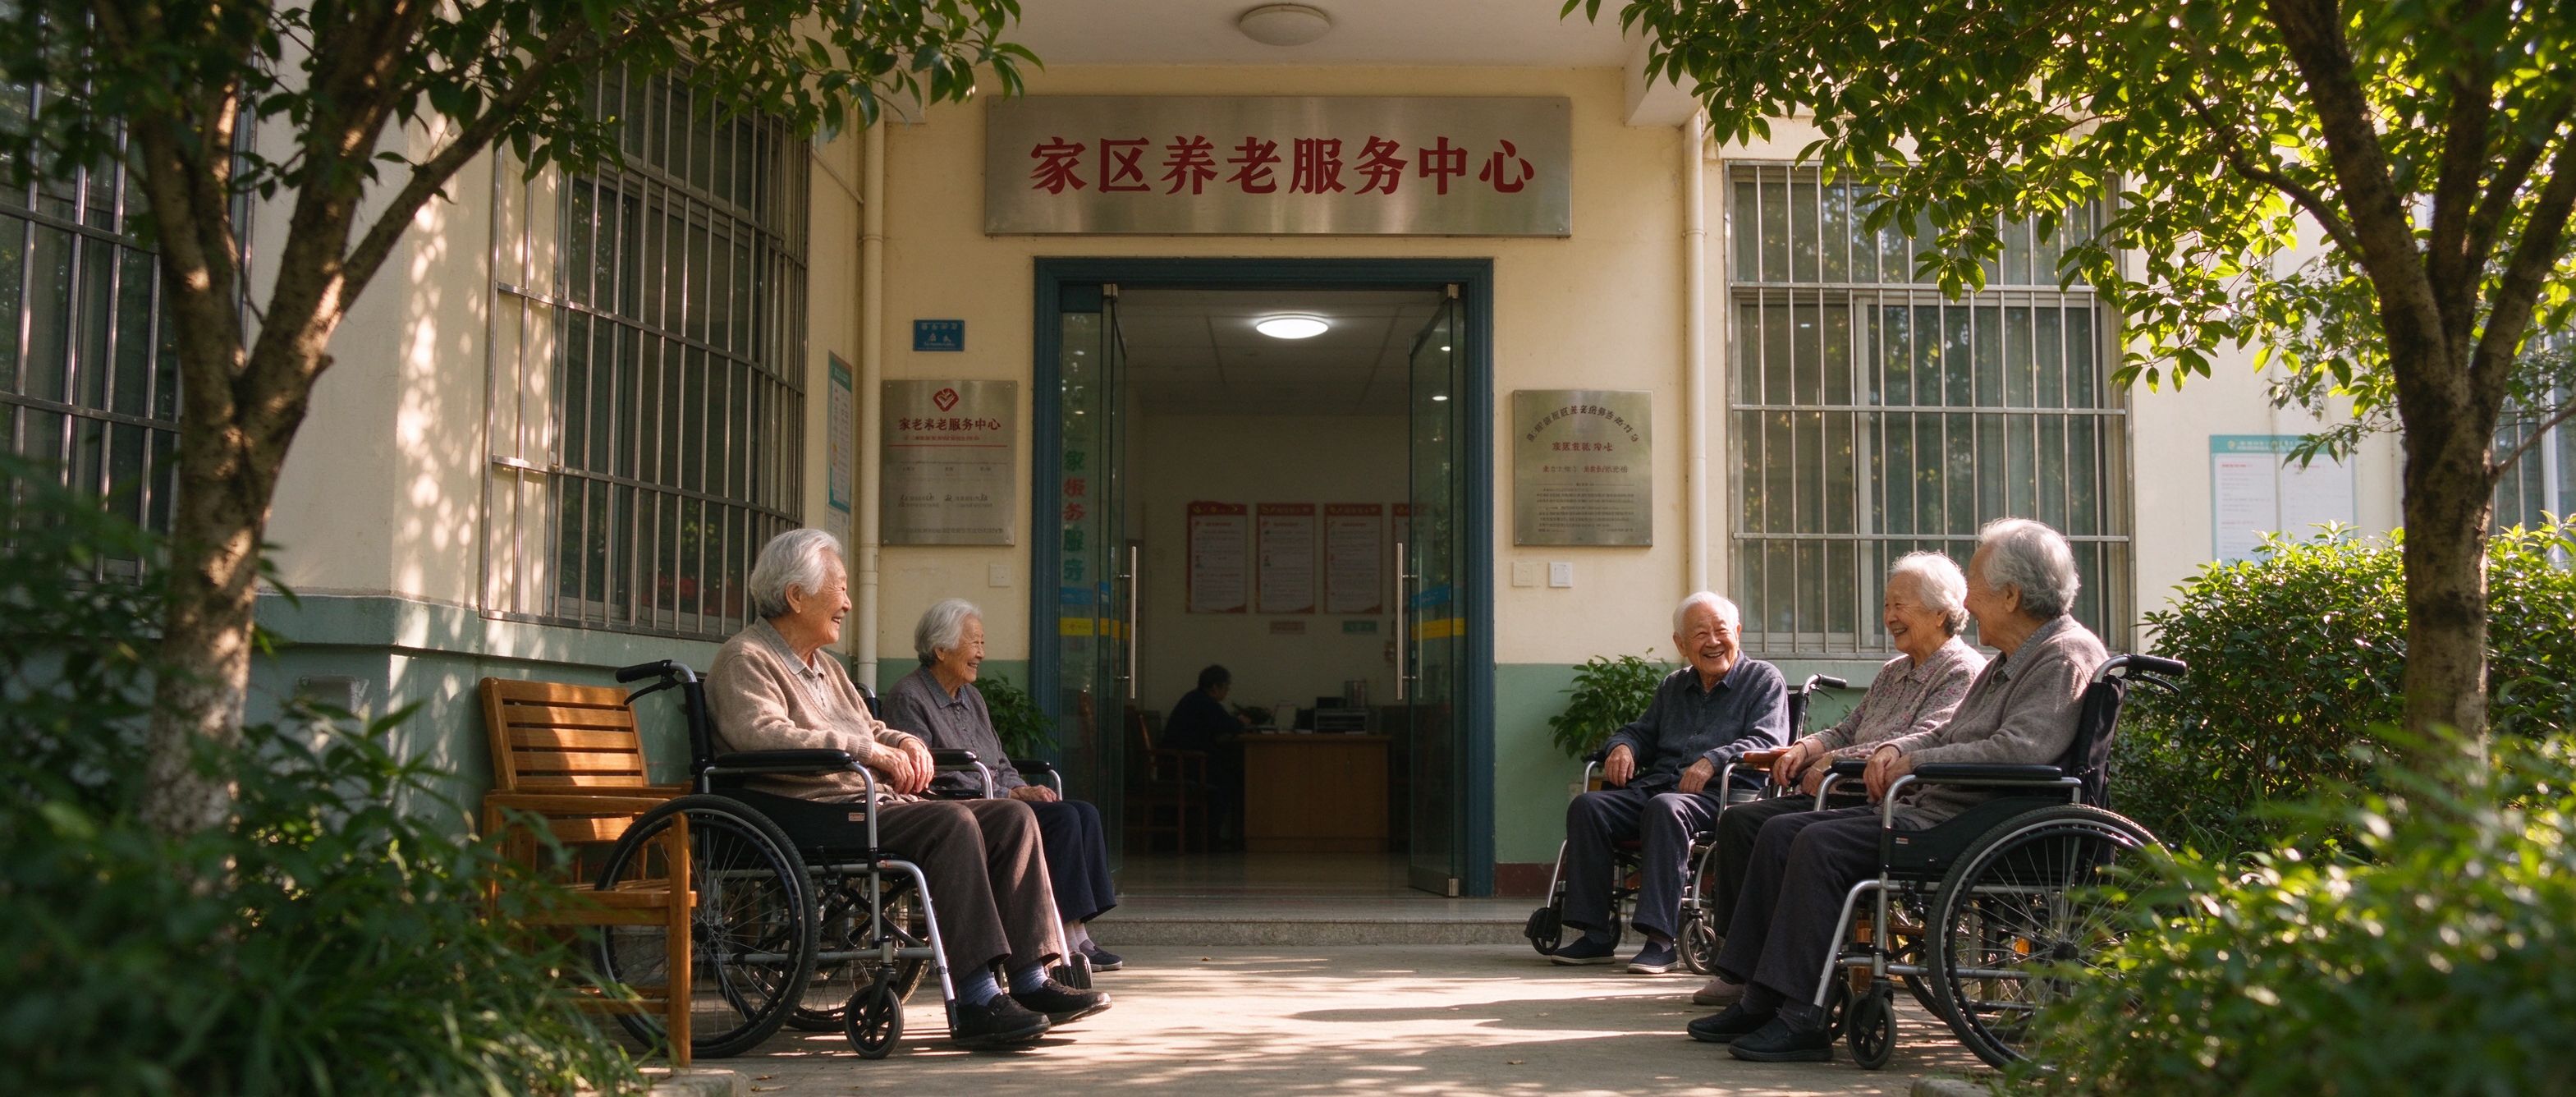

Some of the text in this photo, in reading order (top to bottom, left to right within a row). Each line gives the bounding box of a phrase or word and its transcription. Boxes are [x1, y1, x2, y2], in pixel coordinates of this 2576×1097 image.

[1031, 135, 1534, 195] 家区养老服务中心
